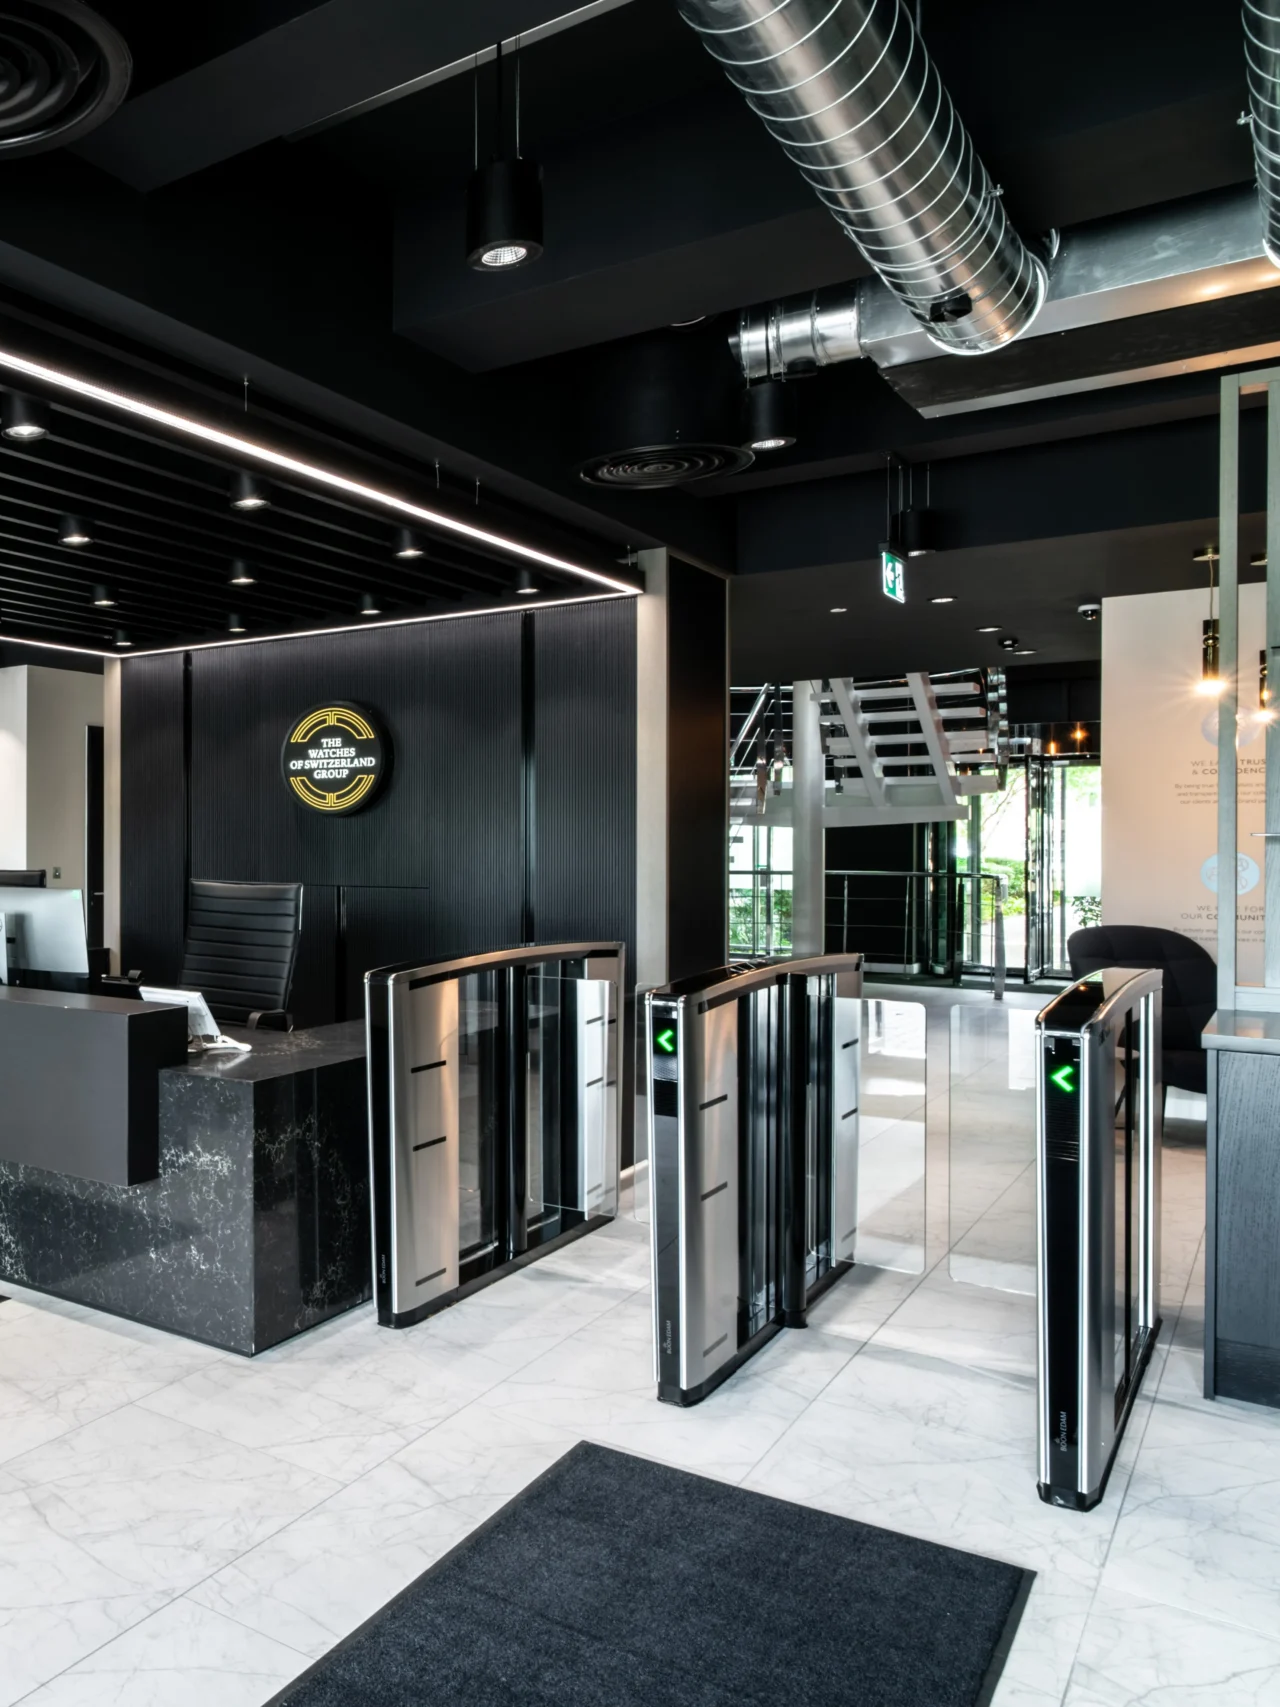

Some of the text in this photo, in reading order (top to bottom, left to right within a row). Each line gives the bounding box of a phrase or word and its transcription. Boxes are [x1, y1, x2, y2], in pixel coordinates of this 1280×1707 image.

[321, 738, 342, 748] THE
[308, 748, 356, 759] WATCHES
[290, 757, 376, 770] OF SWITZERLAND
[314, 769, 349, 779] GROUP
